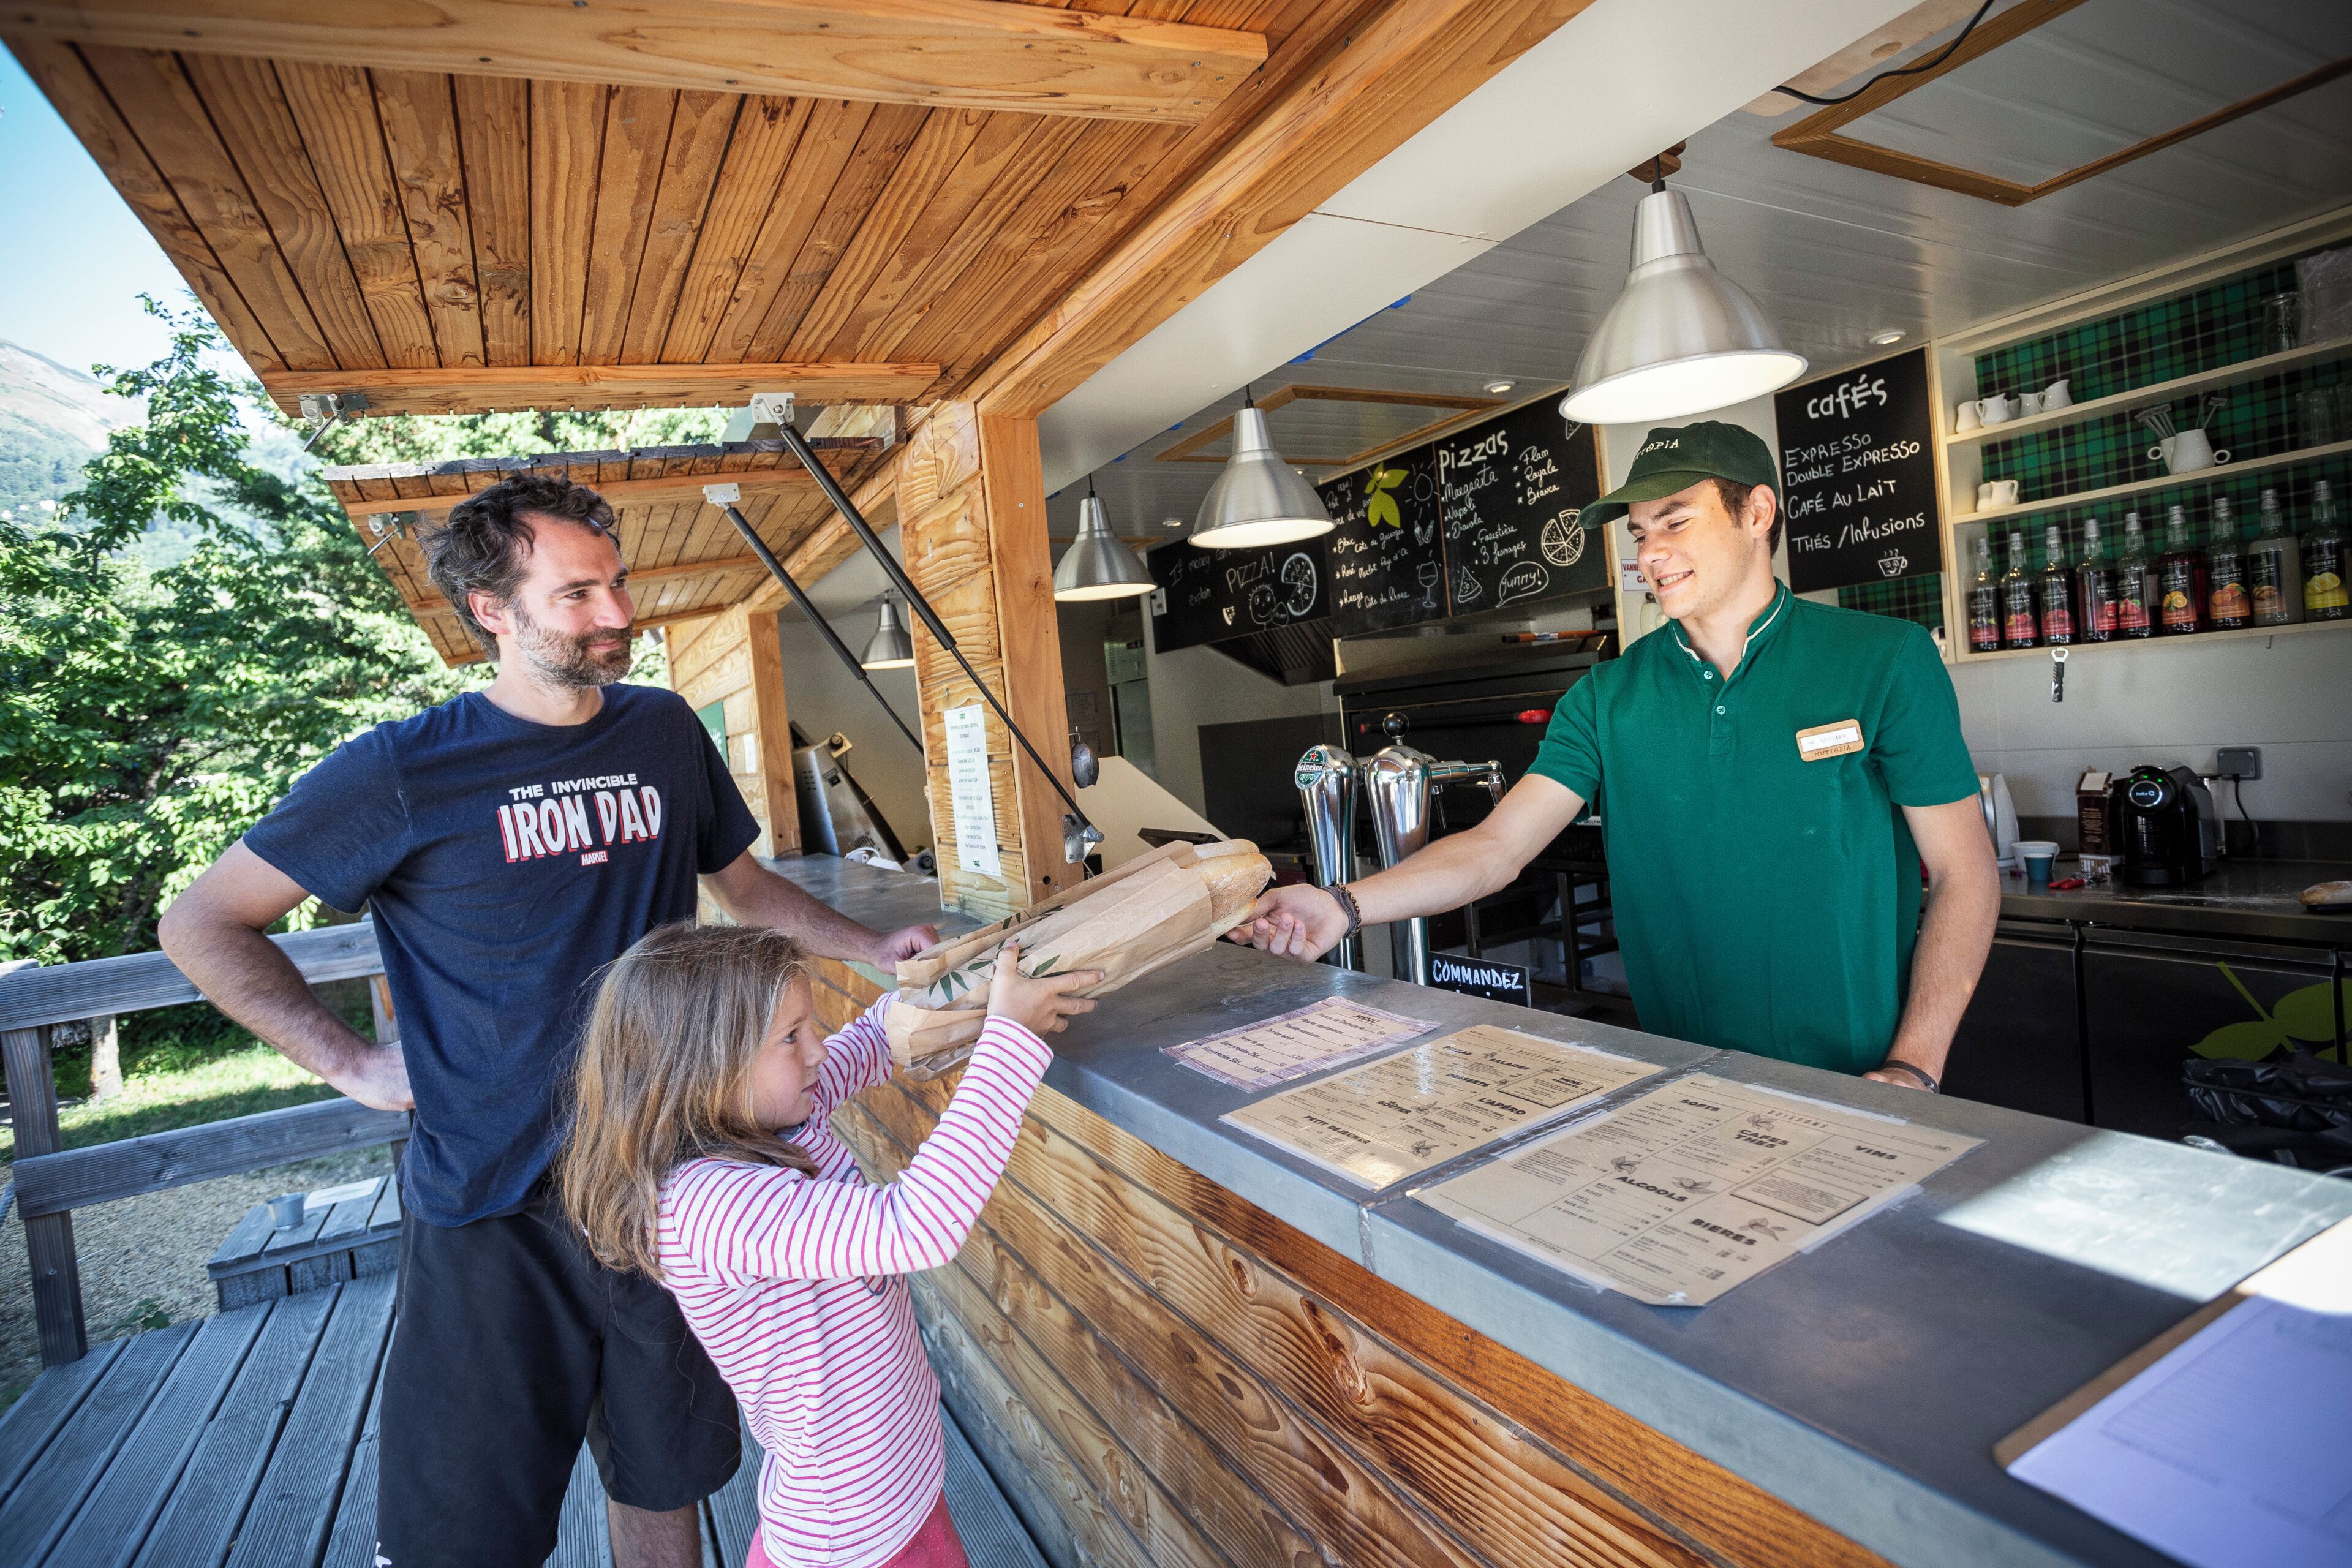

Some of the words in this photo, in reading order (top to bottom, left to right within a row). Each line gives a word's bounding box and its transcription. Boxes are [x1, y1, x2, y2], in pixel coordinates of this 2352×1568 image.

[509, 784, 543, 801] THE
[551, 774, 638, 794] INVINCIBLE
[497, 794, 593, 863] IRON
[594, 786, 662, 845] DAD
[581, 850, 608, 866] MARVEL
[1433, 959, 1524, 990] COMMANDEZ
[1490, 1058, 1529, 1069] SALADES
[1447, 1073, 1489, 1087] DESSERTS
[1377, 1100, 1414, 1114] GOÛTER
[1479, 1098, 1528, 1114] L'APÉRO
[1680, 1099, 1721, 1111] SOFTS
[1768, 1111, 1827, 1127] BOISSONS
[1304, 1116, 1327, 1125] PETIT
[1329, 1126, 1370, 1143] DEJEUNER
[1739, 1129, 1789, 1144] CAFES
[1733, 1135, 1776, 1147] THES
[1853, 1146, 1898, 1159] VINS
[1616, 1177, 1688, 1200] ALCOOLS
[1690, 1219, 1758, 1245] BIERES
